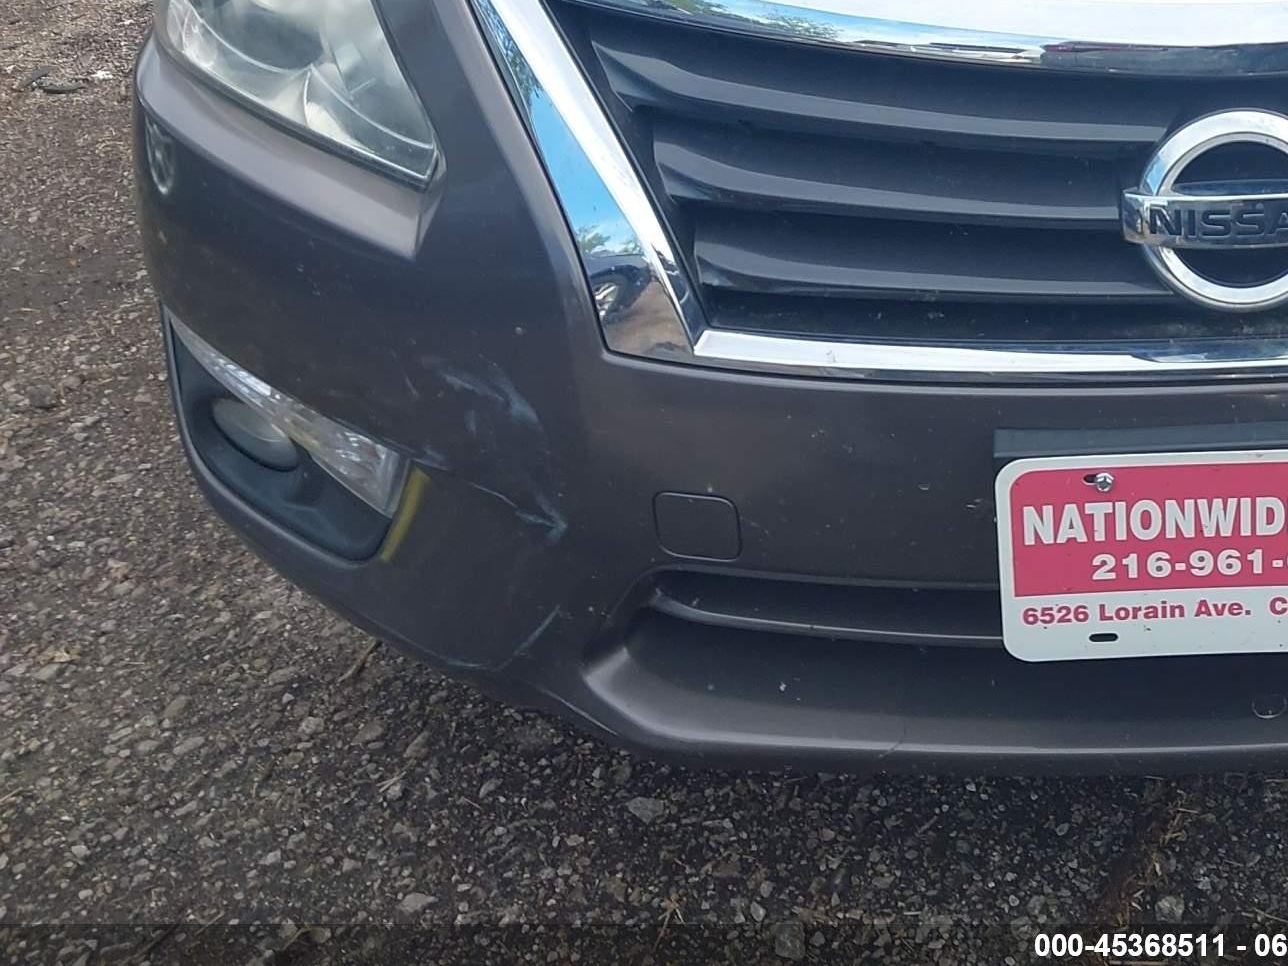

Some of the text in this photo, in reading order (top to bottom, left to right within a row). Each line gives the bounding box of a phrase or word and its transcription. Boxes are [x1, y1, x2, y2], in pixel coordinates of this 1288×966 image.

[1022, 603, 1090, 626] 6526
[1098, 599, 1186, 622] Lorain
[1194, 598, 1252, 618] Ave.
